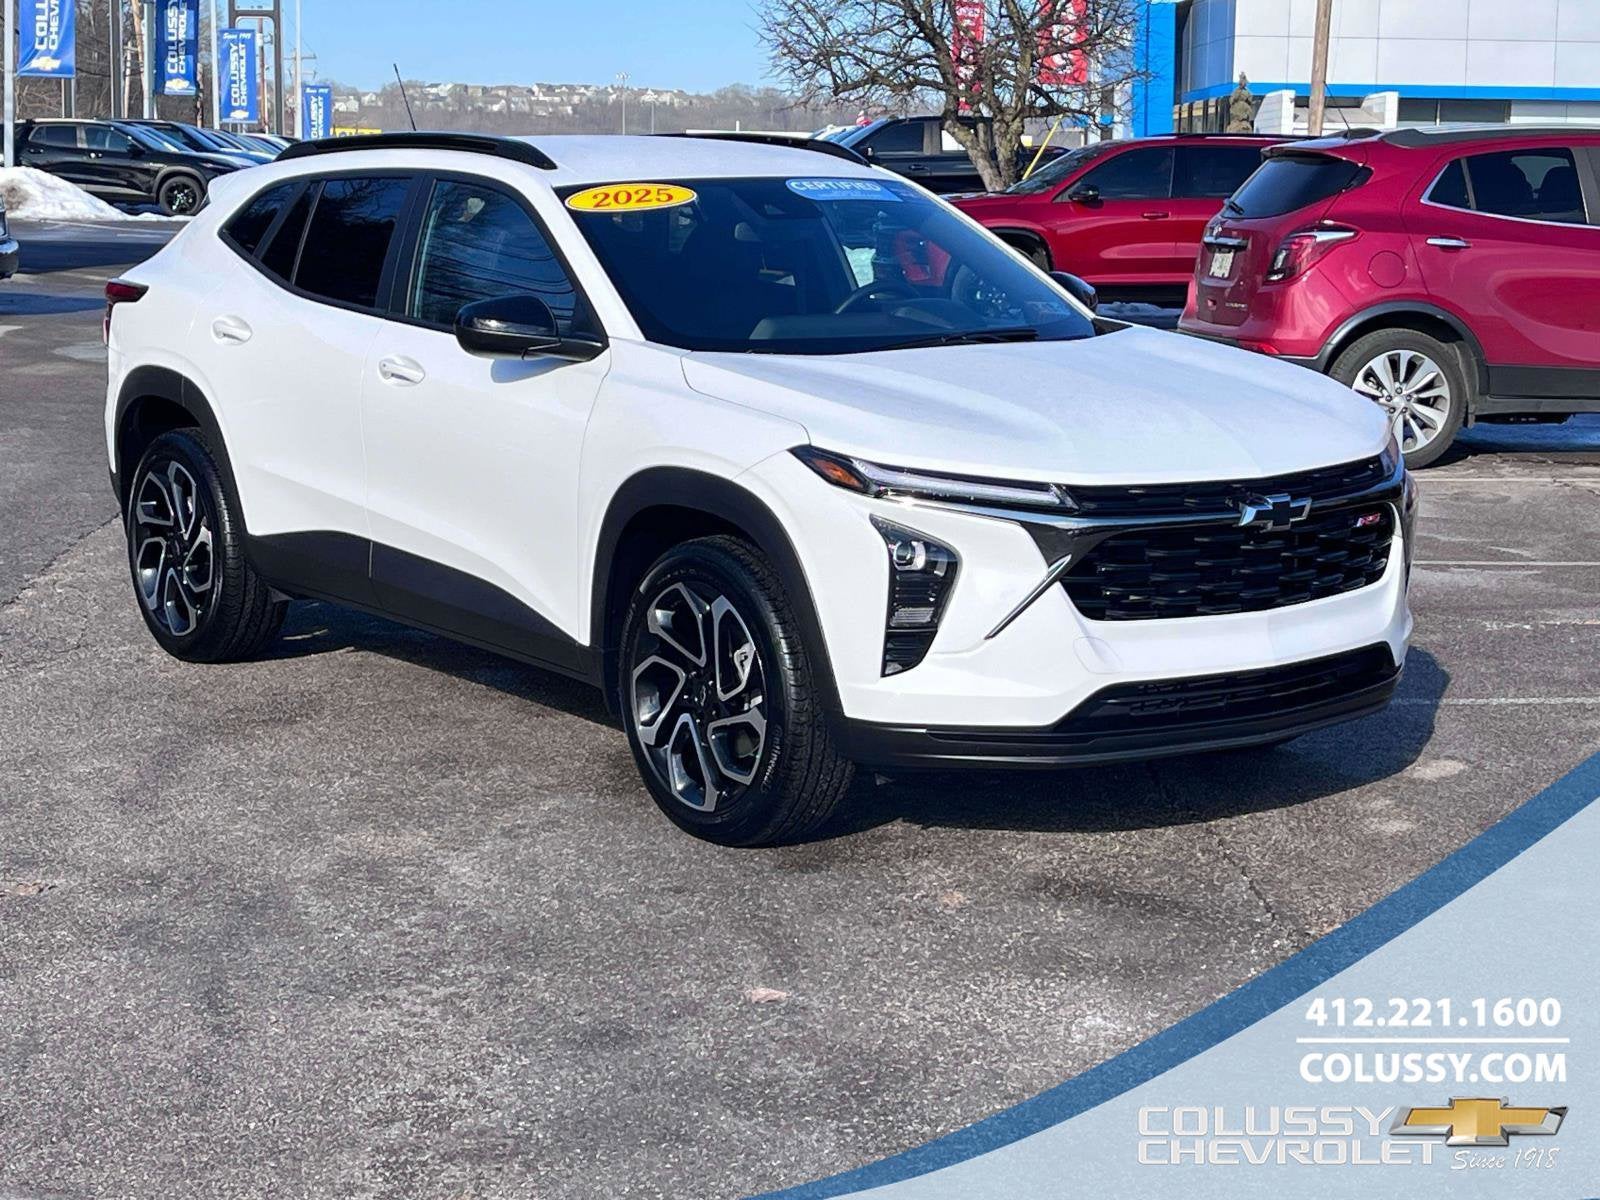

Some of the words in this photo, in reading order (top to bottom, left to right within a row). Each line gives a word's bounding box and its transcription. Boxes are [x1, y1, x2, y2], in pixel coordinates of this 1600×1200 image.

[230, 42, 240, 106] COLUSSY
[790, 181, 882, 191] CERTIFIED
[592, 188, 674, 208] 2025
